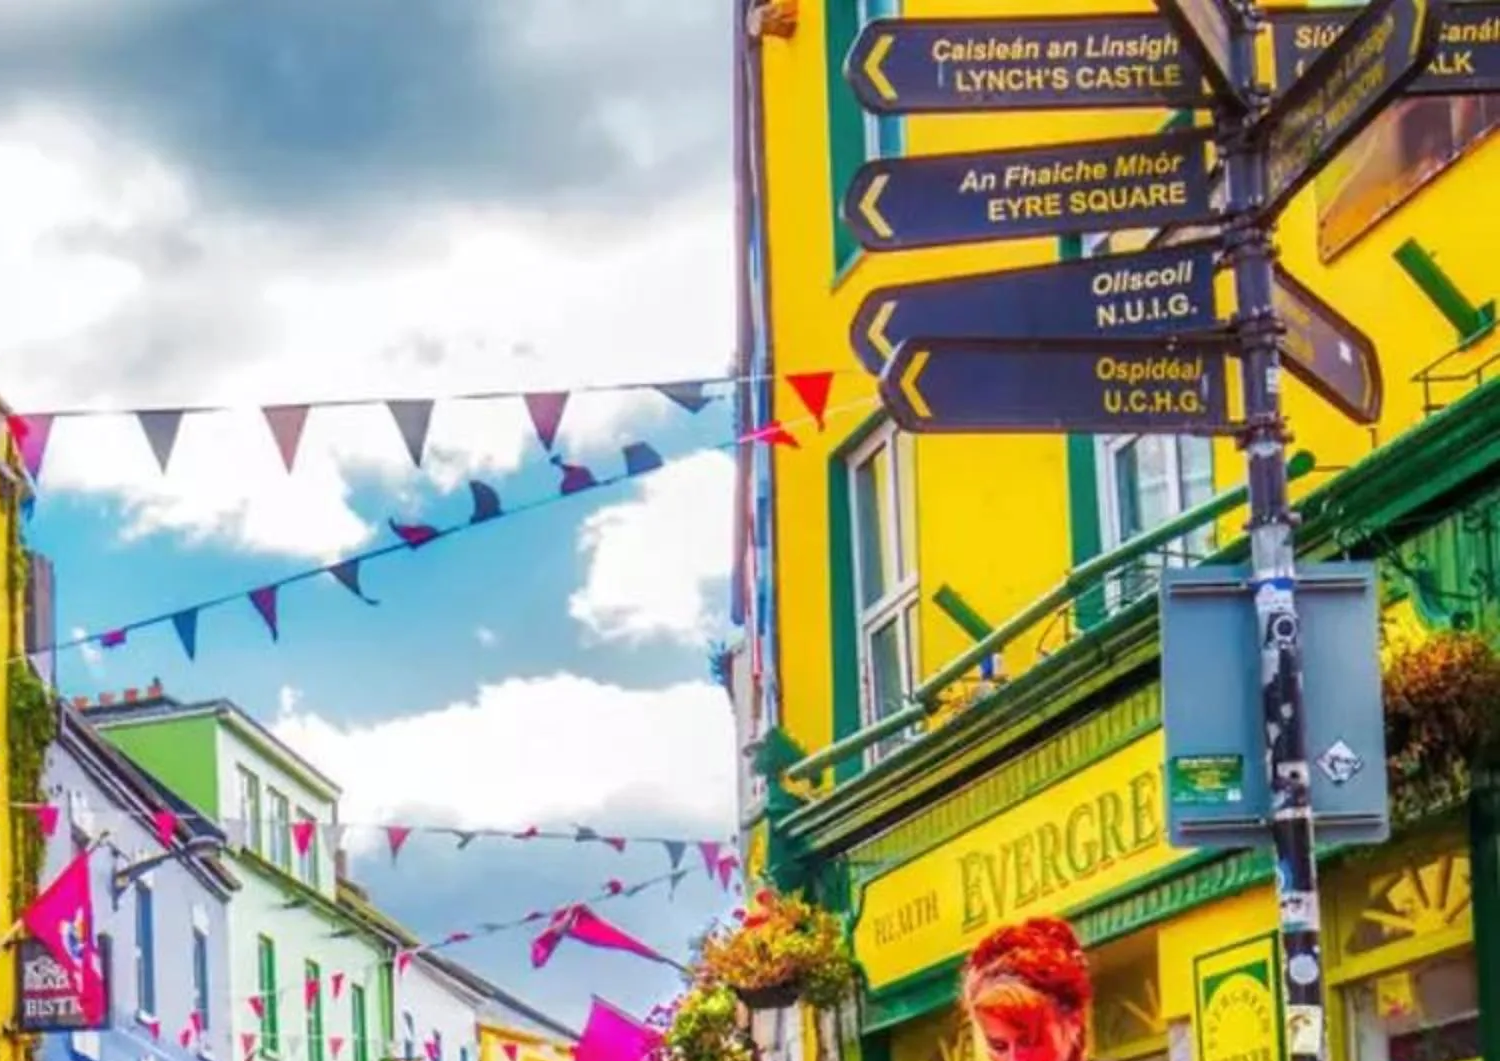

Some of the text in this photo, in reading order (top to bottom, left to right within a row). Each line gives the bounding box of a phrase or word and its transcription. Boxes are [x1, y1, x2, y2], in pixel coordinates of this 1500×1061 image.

[932, 32, 1181, 62] Caisleán an Linsigh
[956, 63, 1184, 92] LYNCH'S CASTLE
[959, 152, 1185, 193] An Fhaiche Mhór
[987, 181, 1188, 222] EYRE SQUARE
[1092, 259, 1194, 296] Ollscoil
[1096, 293, 1198, 328] N.U.I.G.
[1095, 355, 1204, 385] Ospidéal
[1104, 389, 1207, 414] U.C.H.G.
[958, 768, 1165, 935] EVERGRE
